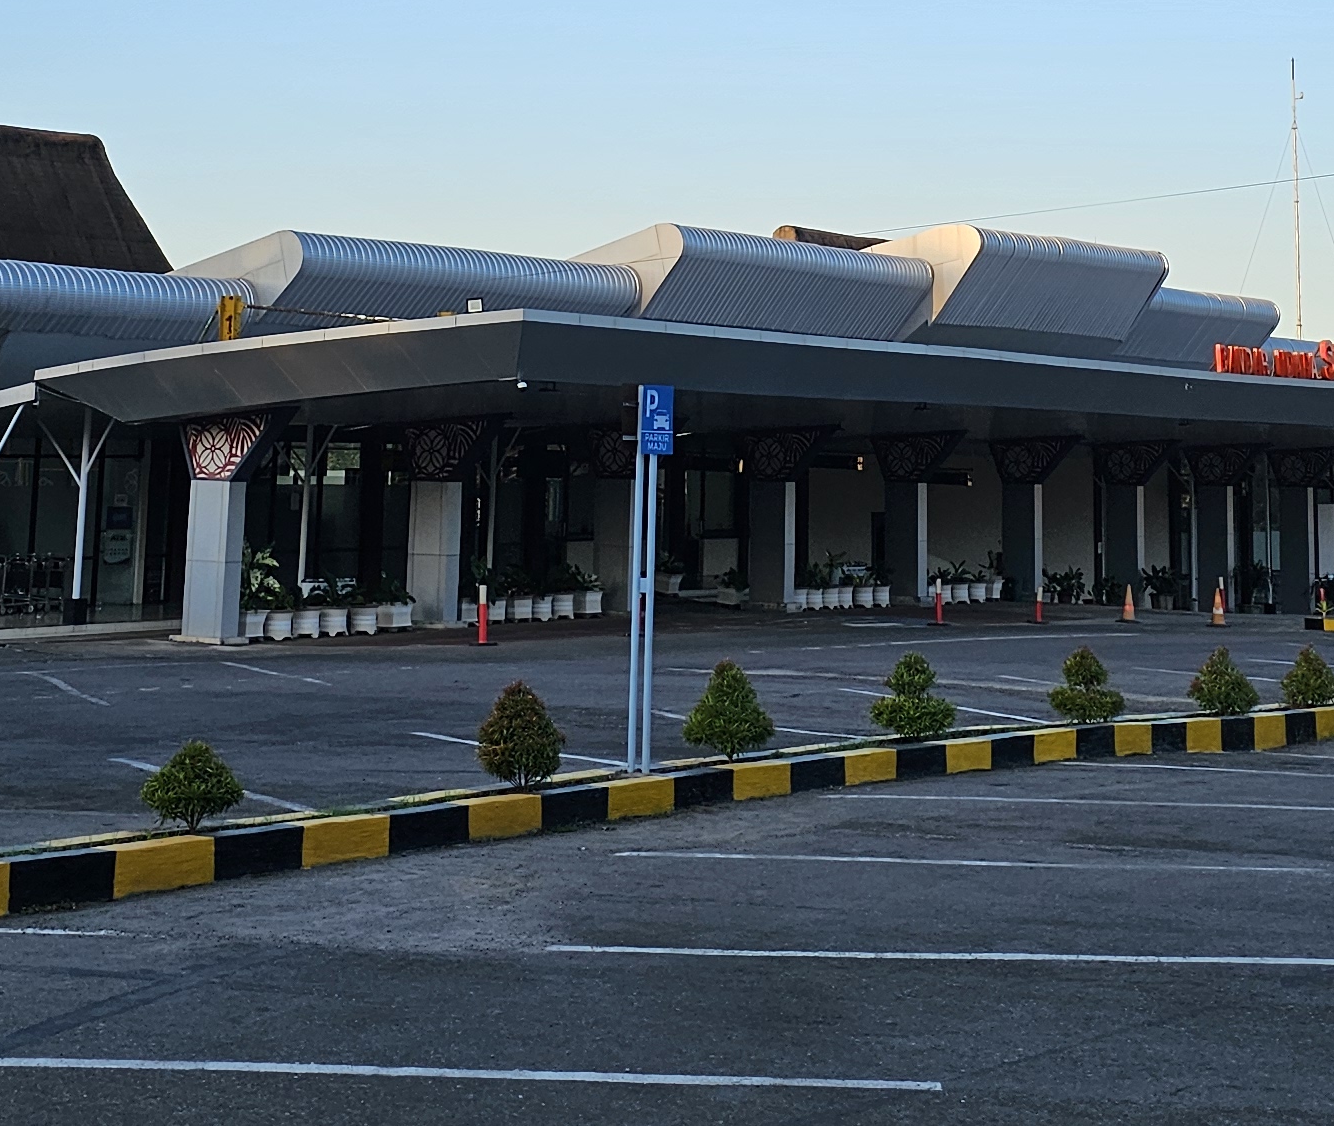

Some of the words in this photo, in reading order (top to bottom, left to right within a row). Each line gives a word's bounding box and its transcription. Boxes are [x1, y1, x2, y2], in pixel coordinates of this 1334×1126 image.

[646, 390, 658, 417] P
[645, 433, 669, 442] PARKIR
[647, 442, 667, 450] MAJU
